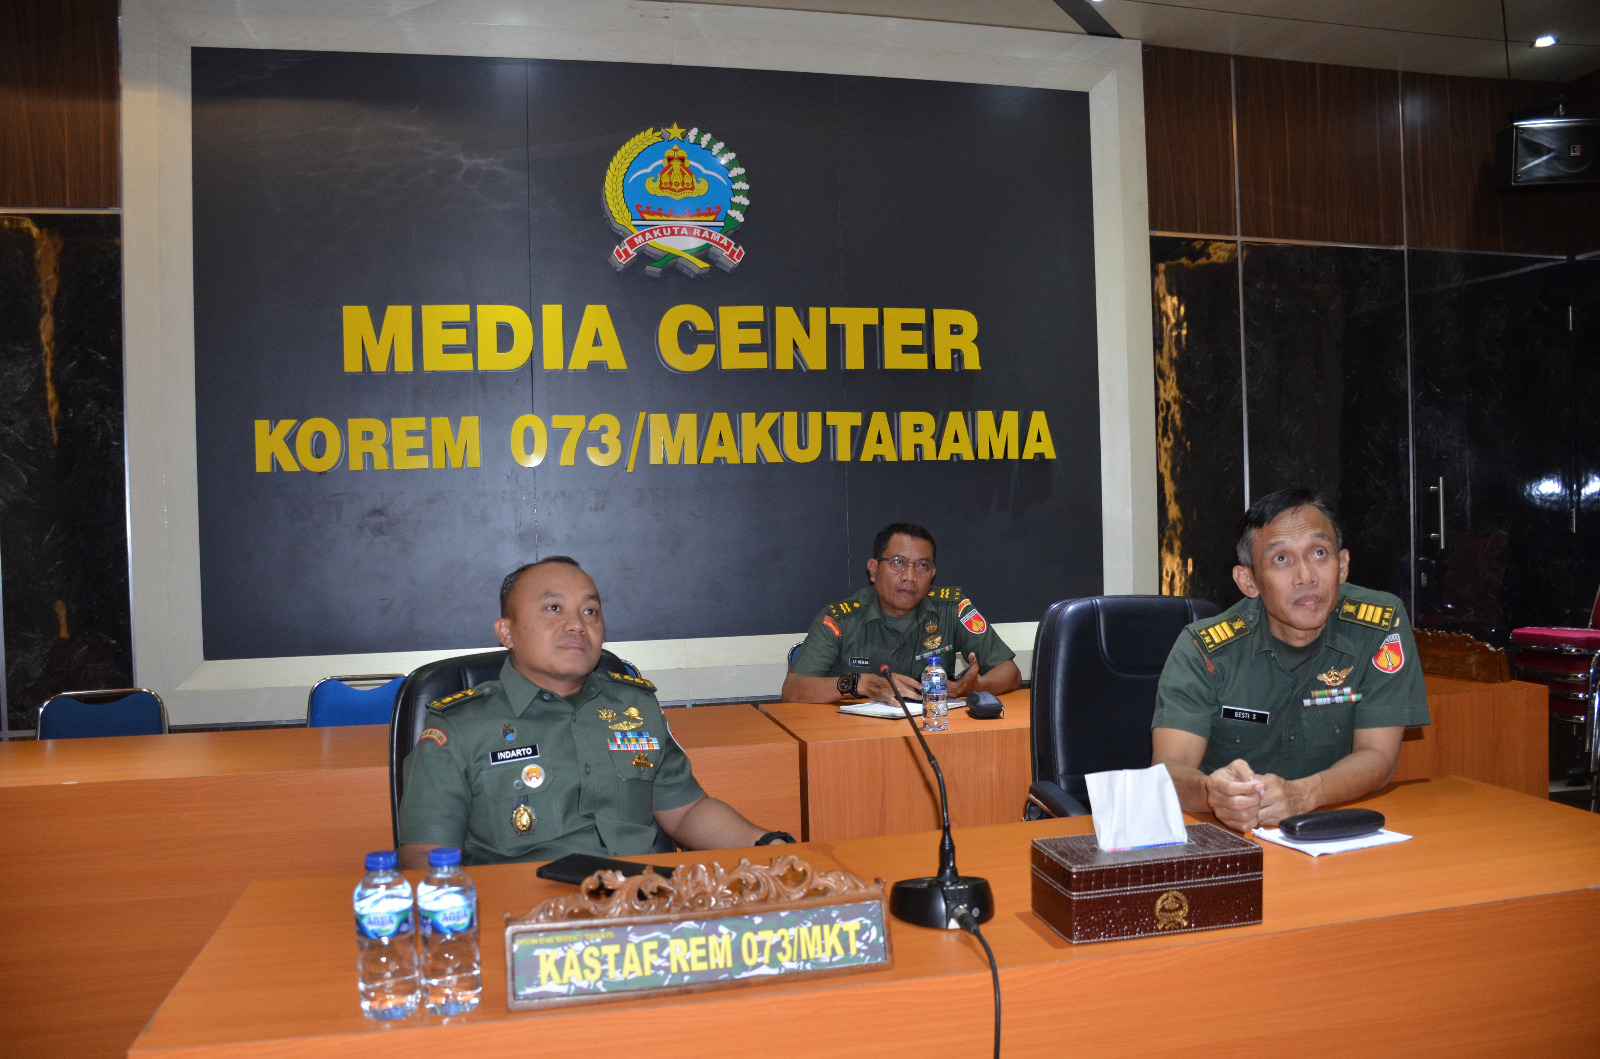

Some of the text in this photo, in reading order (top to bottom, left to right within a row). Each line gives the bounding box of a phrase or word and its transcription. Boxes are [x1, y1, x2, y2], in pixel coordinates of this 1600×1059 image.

[634, 227, 728, 246] MAKUTA RAMA
[342, 303, 982, 373] MEDIA CENTER
[253, 410, 1057, 473] KOREM 073/MAKUTARAMA
[1381, 607, 1393, 627] TNI
[1200, 629, 1215, 649] TNI
[1234, 711, 1250, 720] BESTI
[498, 746, 533, 760] INDARTO
[538, 921, 862, 986] KASTAF REM 073/MKT
